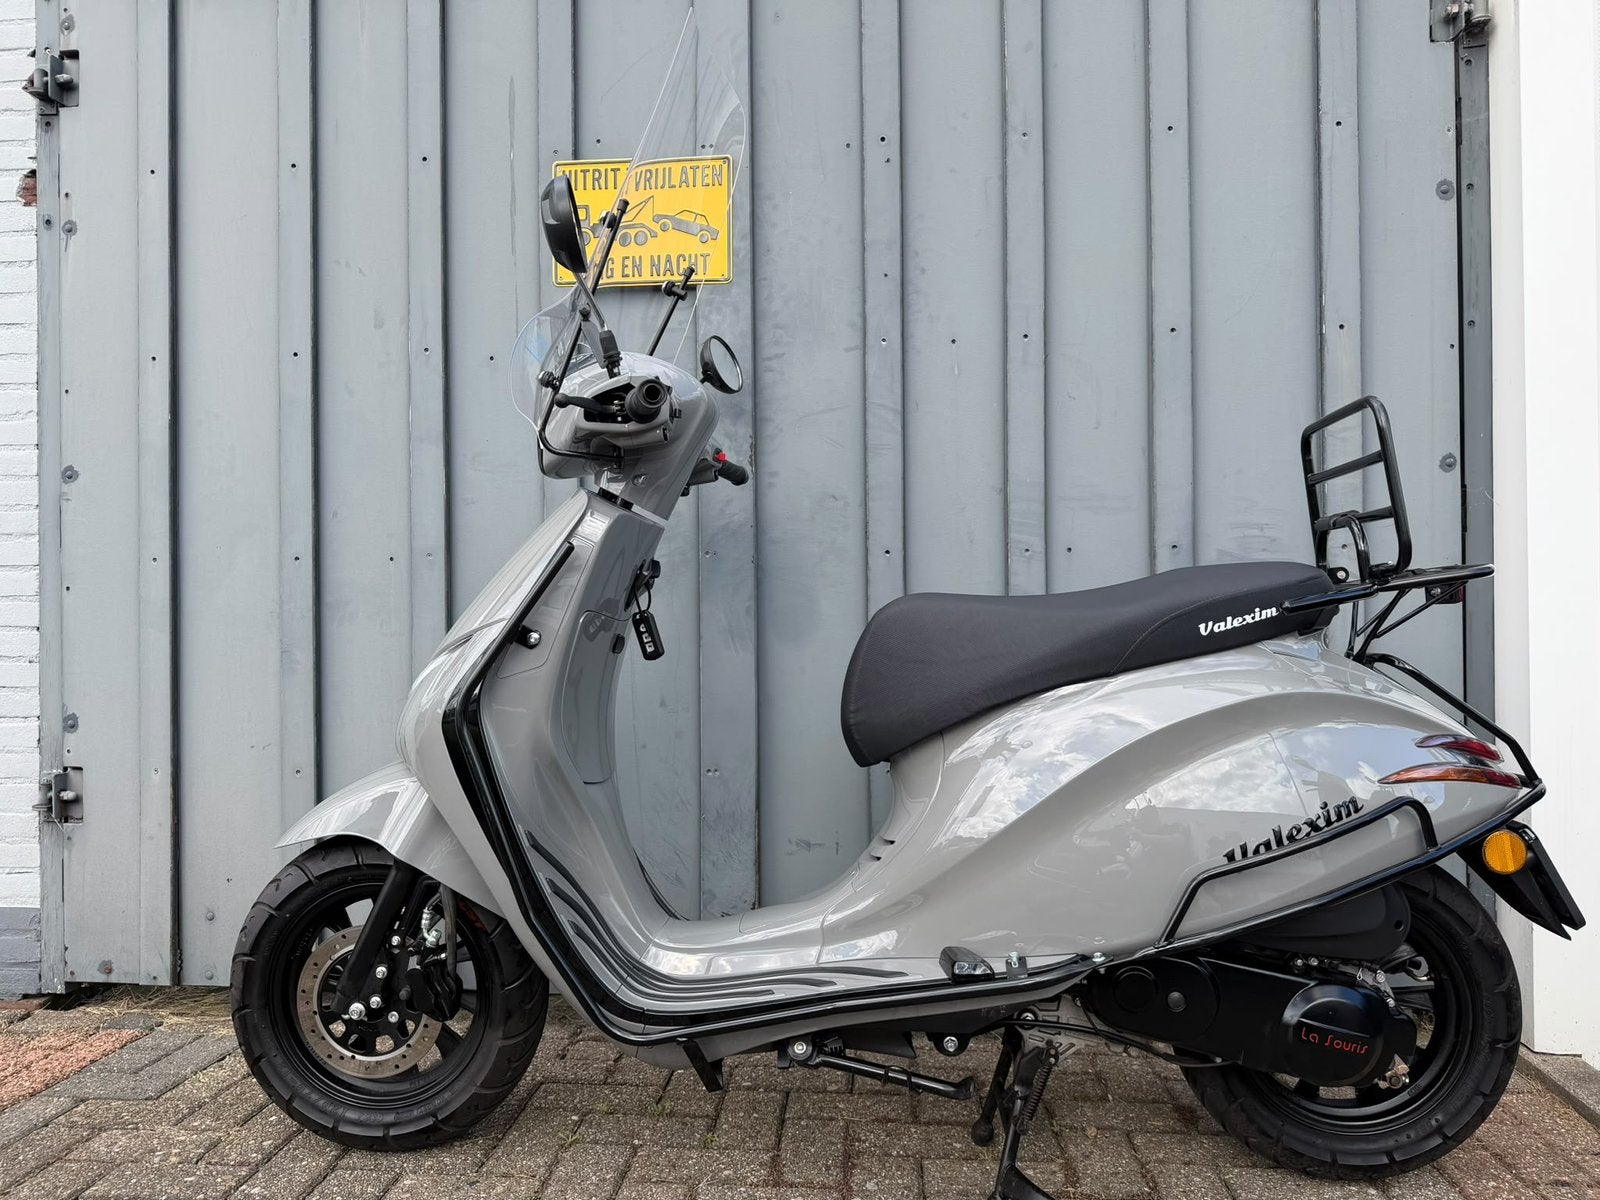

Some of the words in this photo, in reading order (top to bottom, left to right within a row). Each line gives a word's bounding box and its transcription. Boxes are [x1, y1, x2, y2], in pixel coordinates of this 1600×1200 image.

[634, 164, 723, 192] VRIJLATEN
[621, 255, 643, 278] EN
[650, 253, 711, 277] NACHT
[1198, 606, 1280, 636] Valexim
[1301, 1026, 1319, 1043] La
[1324, 1034, 1368, 1054] Souris
